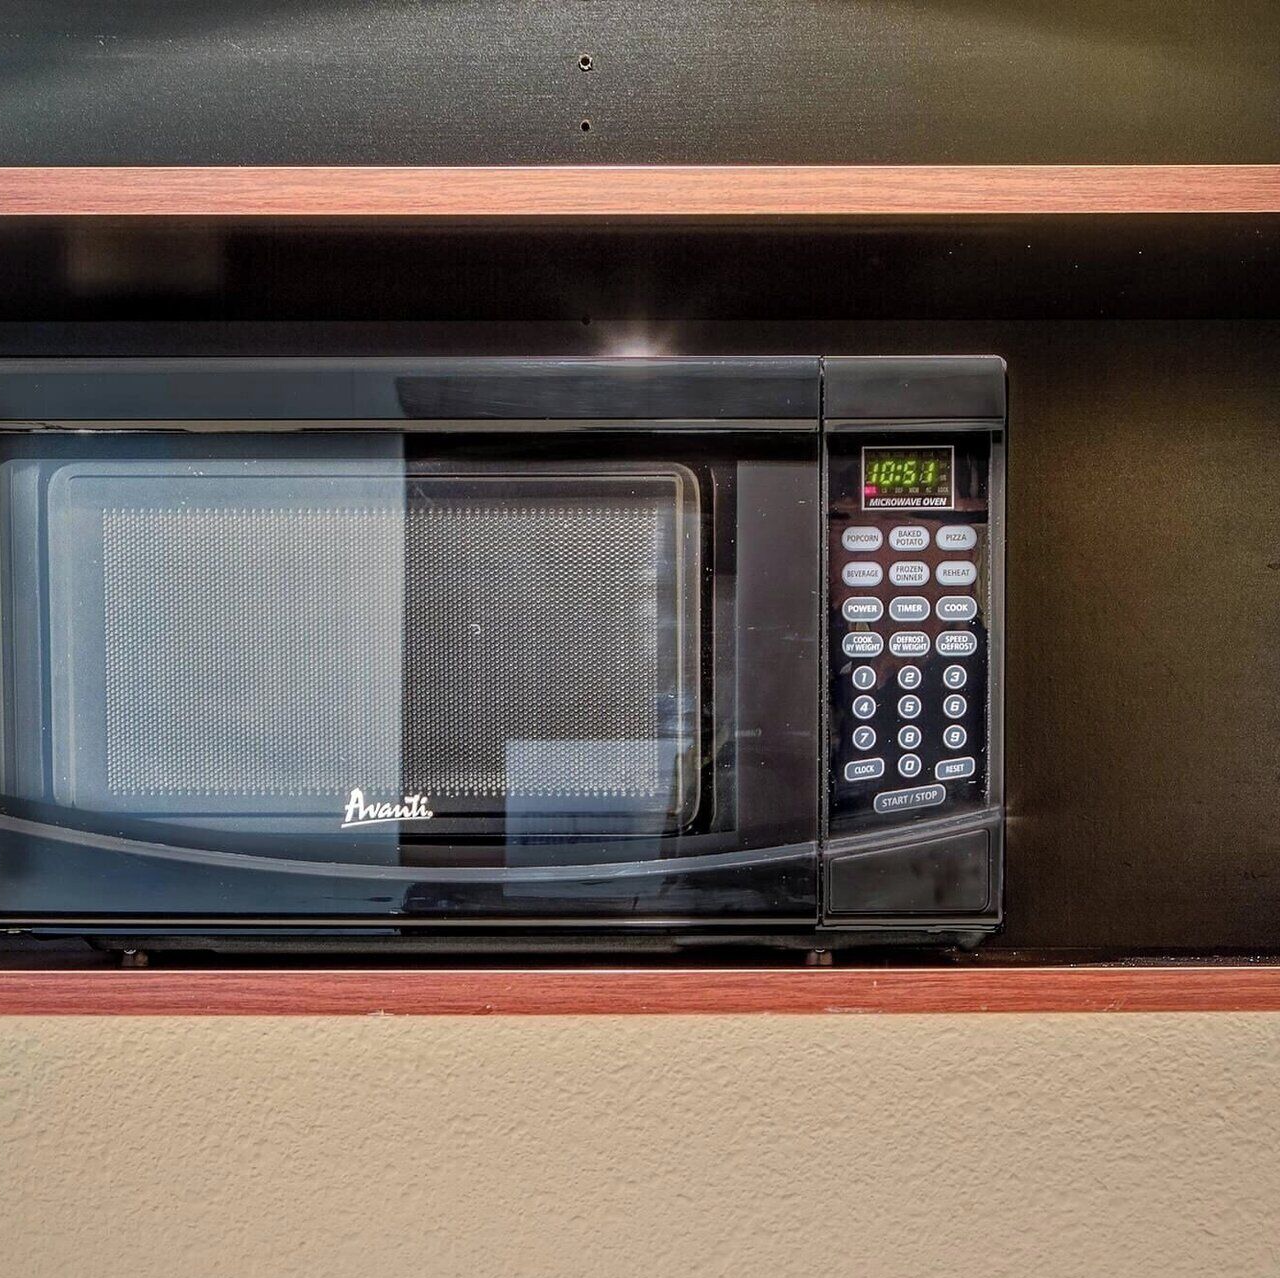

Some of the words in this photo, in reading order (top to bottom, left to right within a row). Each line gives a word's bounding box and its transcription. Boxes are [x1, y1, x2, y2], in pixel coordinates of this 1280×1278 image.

[871, 461, 935, 485] 10:51
[869, 497, 922, 506] MICROWAVE
[922, 497, 947, 506] OVEN
[896, 538, 924, 546] POTATO
[846, 570, 879, 578] BEVERAGE
[942, 569, 970, 577] REHEAT
[847, 604, 878, 613] POWER
[897, 604, 923, 612] TIMER
[944, 604, 969, 612] COOK
[855, 643, 881, 651] WEIGHT
[861, 672, 867, 683] 1
[905, 672, 915, 683] 2
[950, 672, 960, 682] 3
[859, 701, 868, 712] 4
[905, 701, 914, 712] 5
[950, 701, 960, 711] 6
[859, 733, 868, 743] 7
[905, 732, 914, 743] 8
[951, 732, 960, 742] 9
[854, 765, 875, 774] CLOCK
[905, 760, 915, 771] 0
[945, 764, 965, 773] RESET
[882, 795, 908, 808] START
[915, 790, 938, 803] STOP
[344, 787, 429, 823] Avanti
